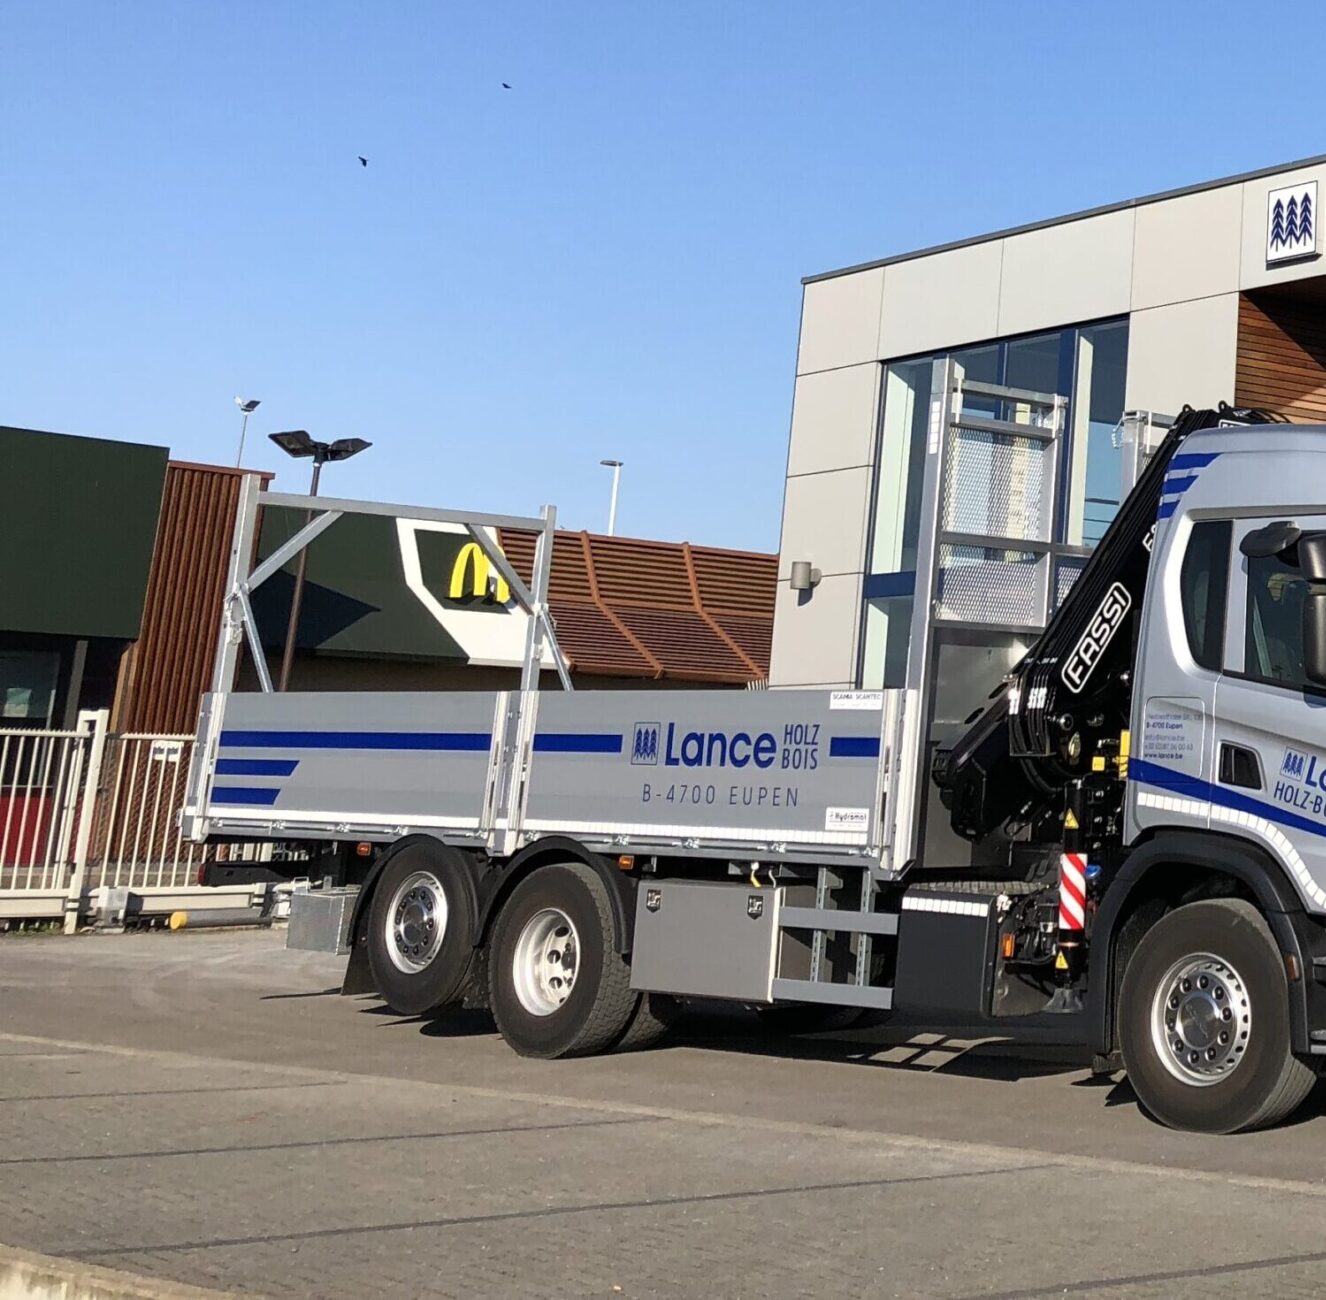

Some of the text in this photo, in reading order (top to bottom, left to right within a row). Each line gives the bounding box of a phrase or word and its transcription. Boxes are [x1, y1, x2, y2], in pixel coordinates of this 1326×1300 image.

[1065, 588, 1129, 686] FASSI
[664, 722, 821, 768] Lance HOLZ
[1144, 752, 1183, 760] www.lance.be
[781, 748, 818, 770] BOIS
[729, 785, 799, 808] EUPEN
